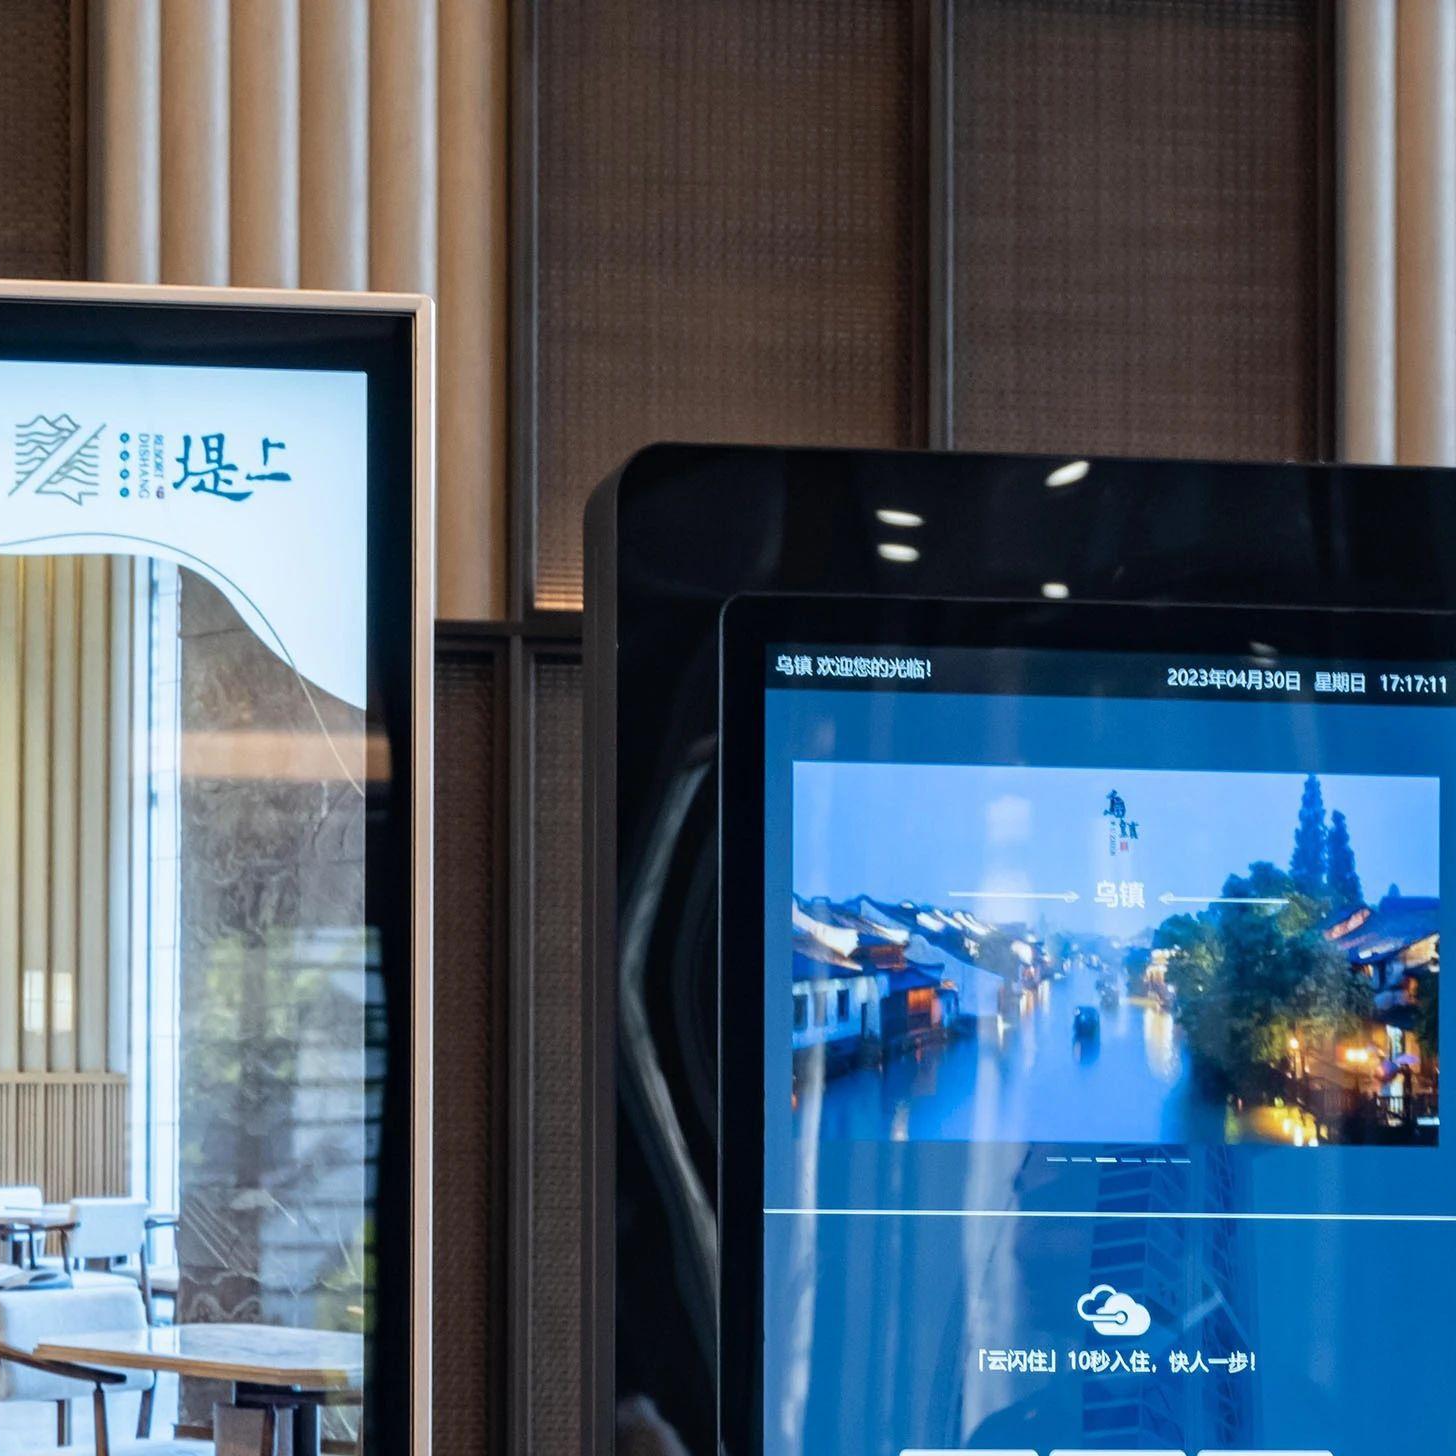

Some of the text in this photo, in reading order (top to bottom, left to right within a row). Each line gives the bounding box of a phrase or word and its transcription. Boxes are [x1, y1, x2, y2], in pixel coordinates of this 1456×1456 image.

[775, 653, 814, 677] 乌镇
[1167, 667, 1447, 694] 2023年04月30日 星期日 17:17:11
[1094, 880, 1145, 909] 乌镇
